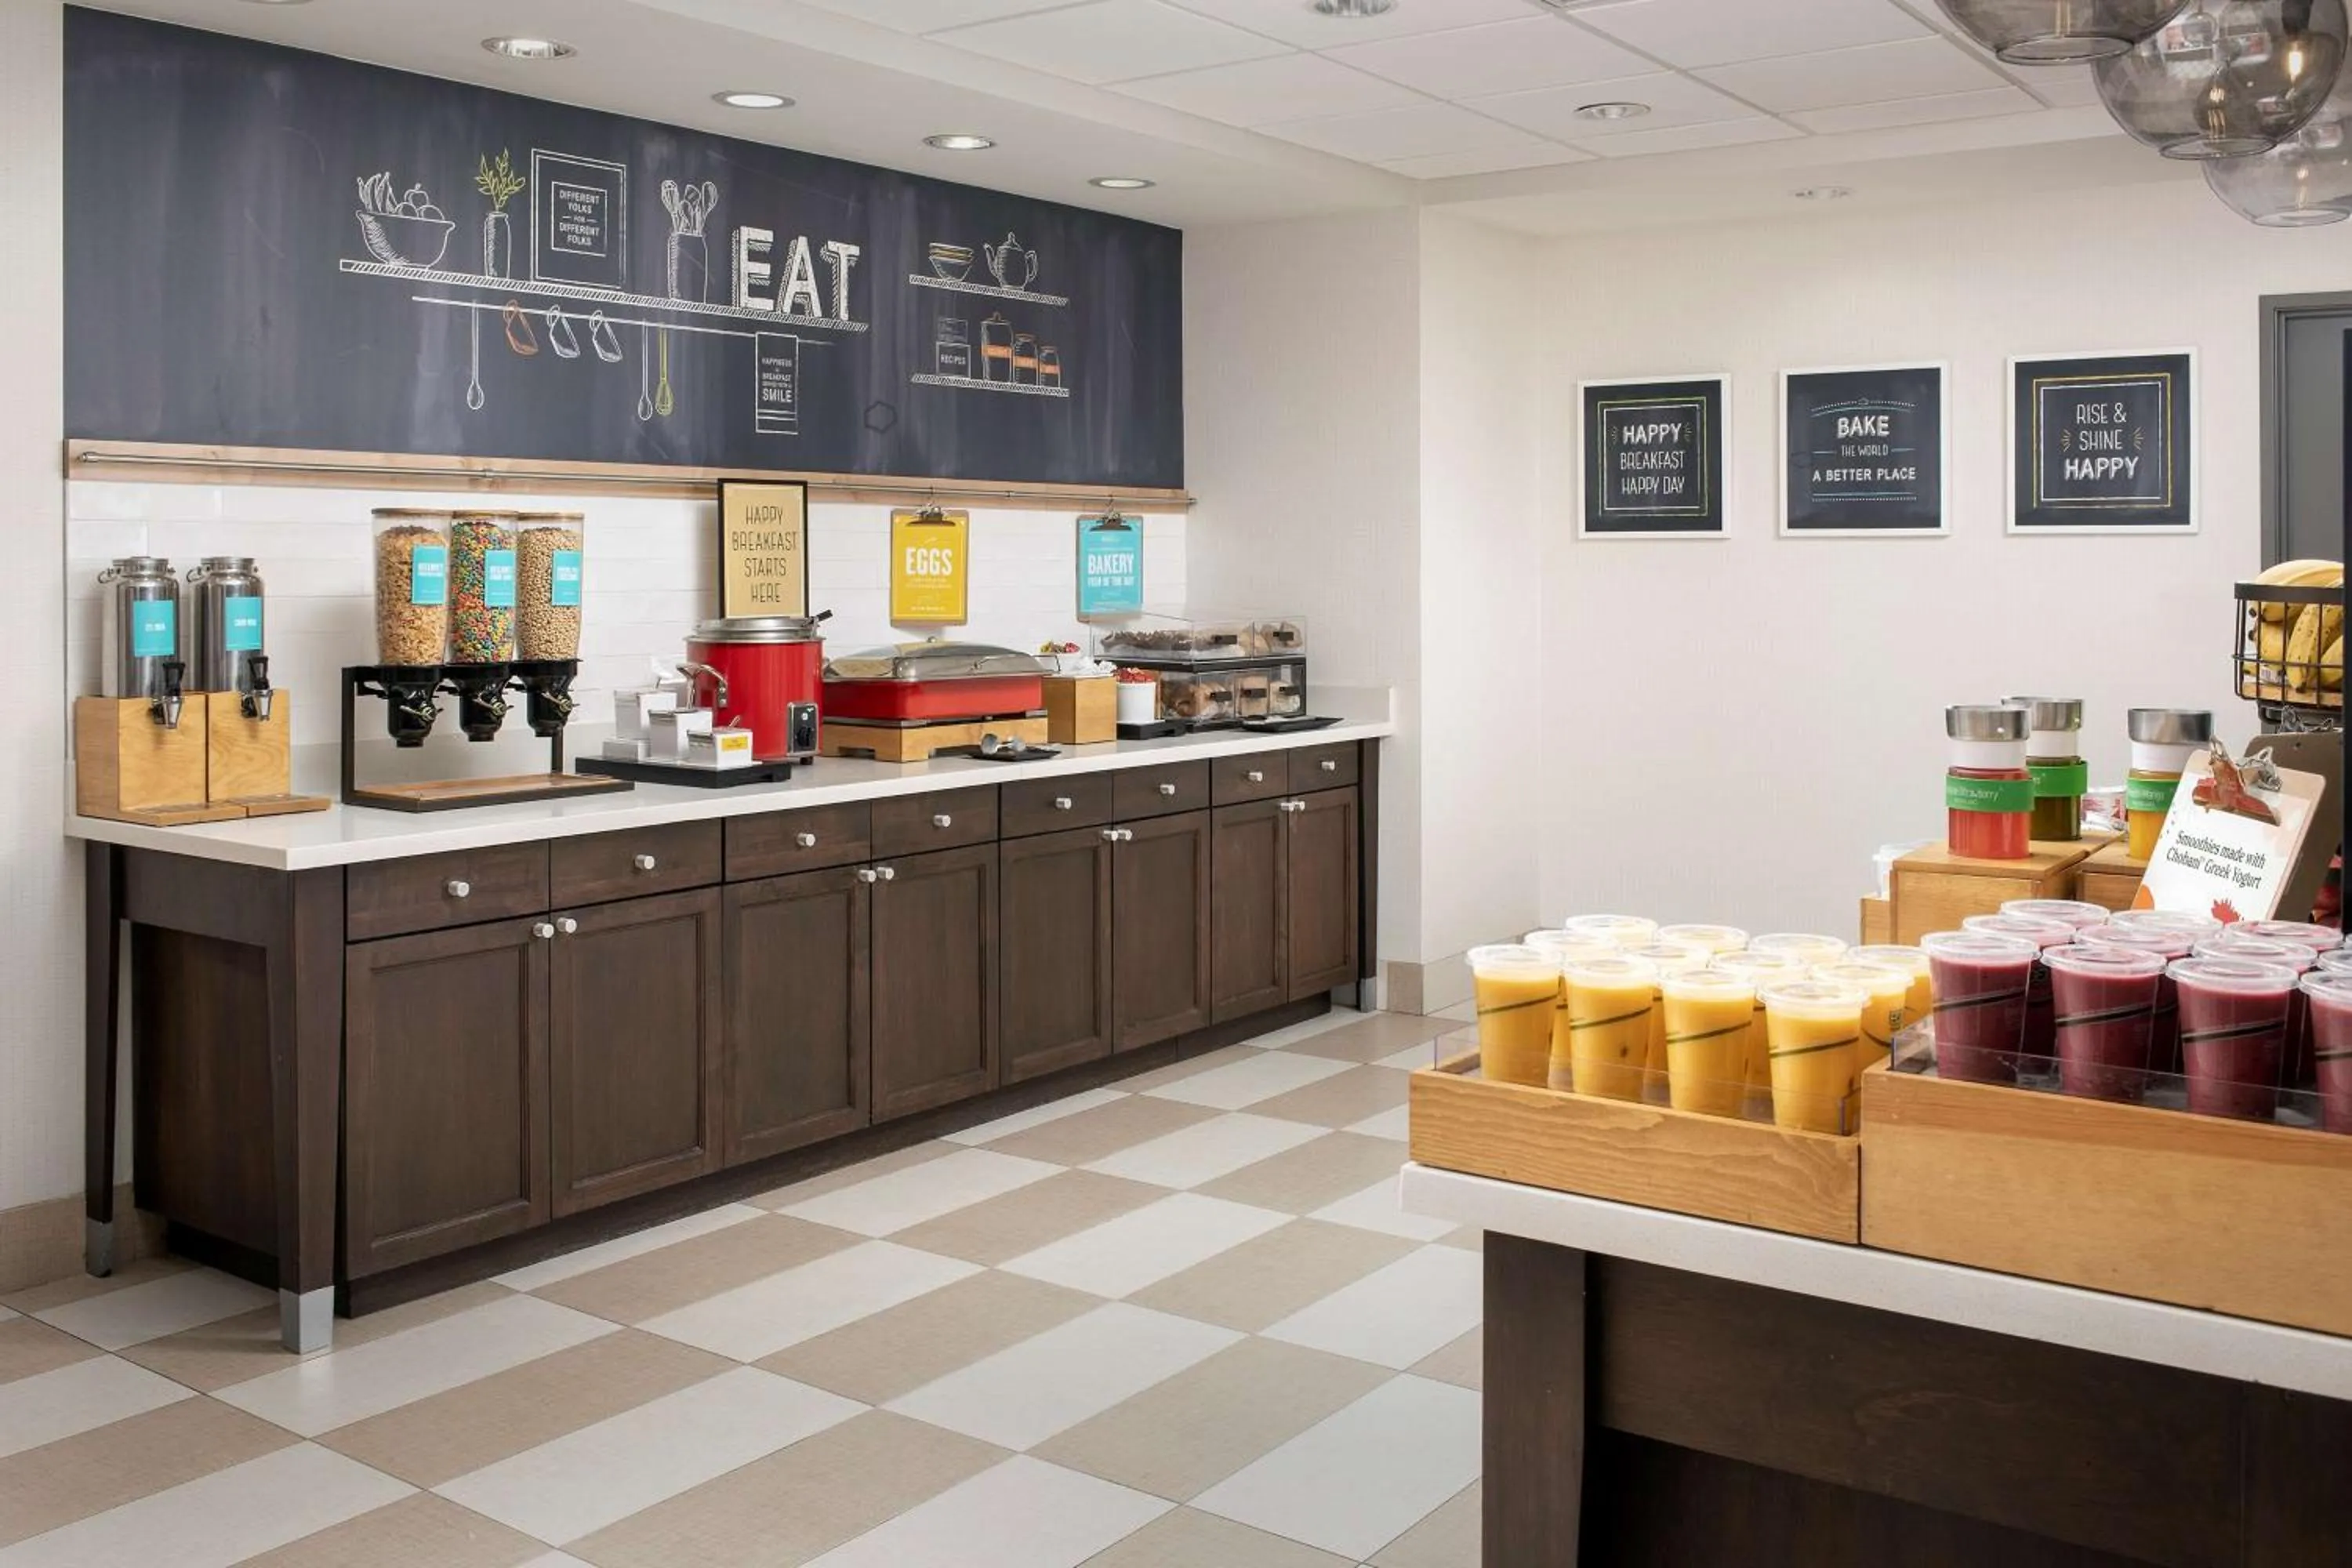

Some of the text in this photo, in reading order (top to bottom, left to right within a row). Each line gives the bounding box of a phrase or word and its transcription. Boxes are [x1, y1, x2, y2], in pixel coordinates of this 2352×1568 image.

[559, 190, 600, 205] DIFFERENT
[559, 222, 601, 237] DIFFERENT
[567, 234, 593, 246] FOLKS
[732, 226, 860, 321] EAT
[762, 388, 793, 402] SMILE
[2076, 401, 2128, 425] RISE &
[1622, 423, 1682, 445] HAPPY
[1837, 415, 1890, 438] BAKE
[1841, 444, 1889, 457] THE WORLD
[2078, 429, 2124, 452] SHINE
[1620, 450, 1686, 470] BREAKFAST
[2064, 456, 2140, 481] HAPPY
[1812, 466, 1917, 482] A BETTER PLACE
[1621, 476, 1685, 495] HAPPY DAY
[746, 506, 783, 525] HAPPY
[731, 531, 799, 551] BREAKFAST
[744, 557, 786, 578] STARTS
[906, 547, 953, 576] EGGS
[1087, 552, 1134, 575] BAKERY
[750, 583, 782, 603] HERE
[2176, 830, 2266, 869] Smoothies made with
[2204, 858, 2231, 879] Greek
[2232, 866, 2262, 889] Yogurt
